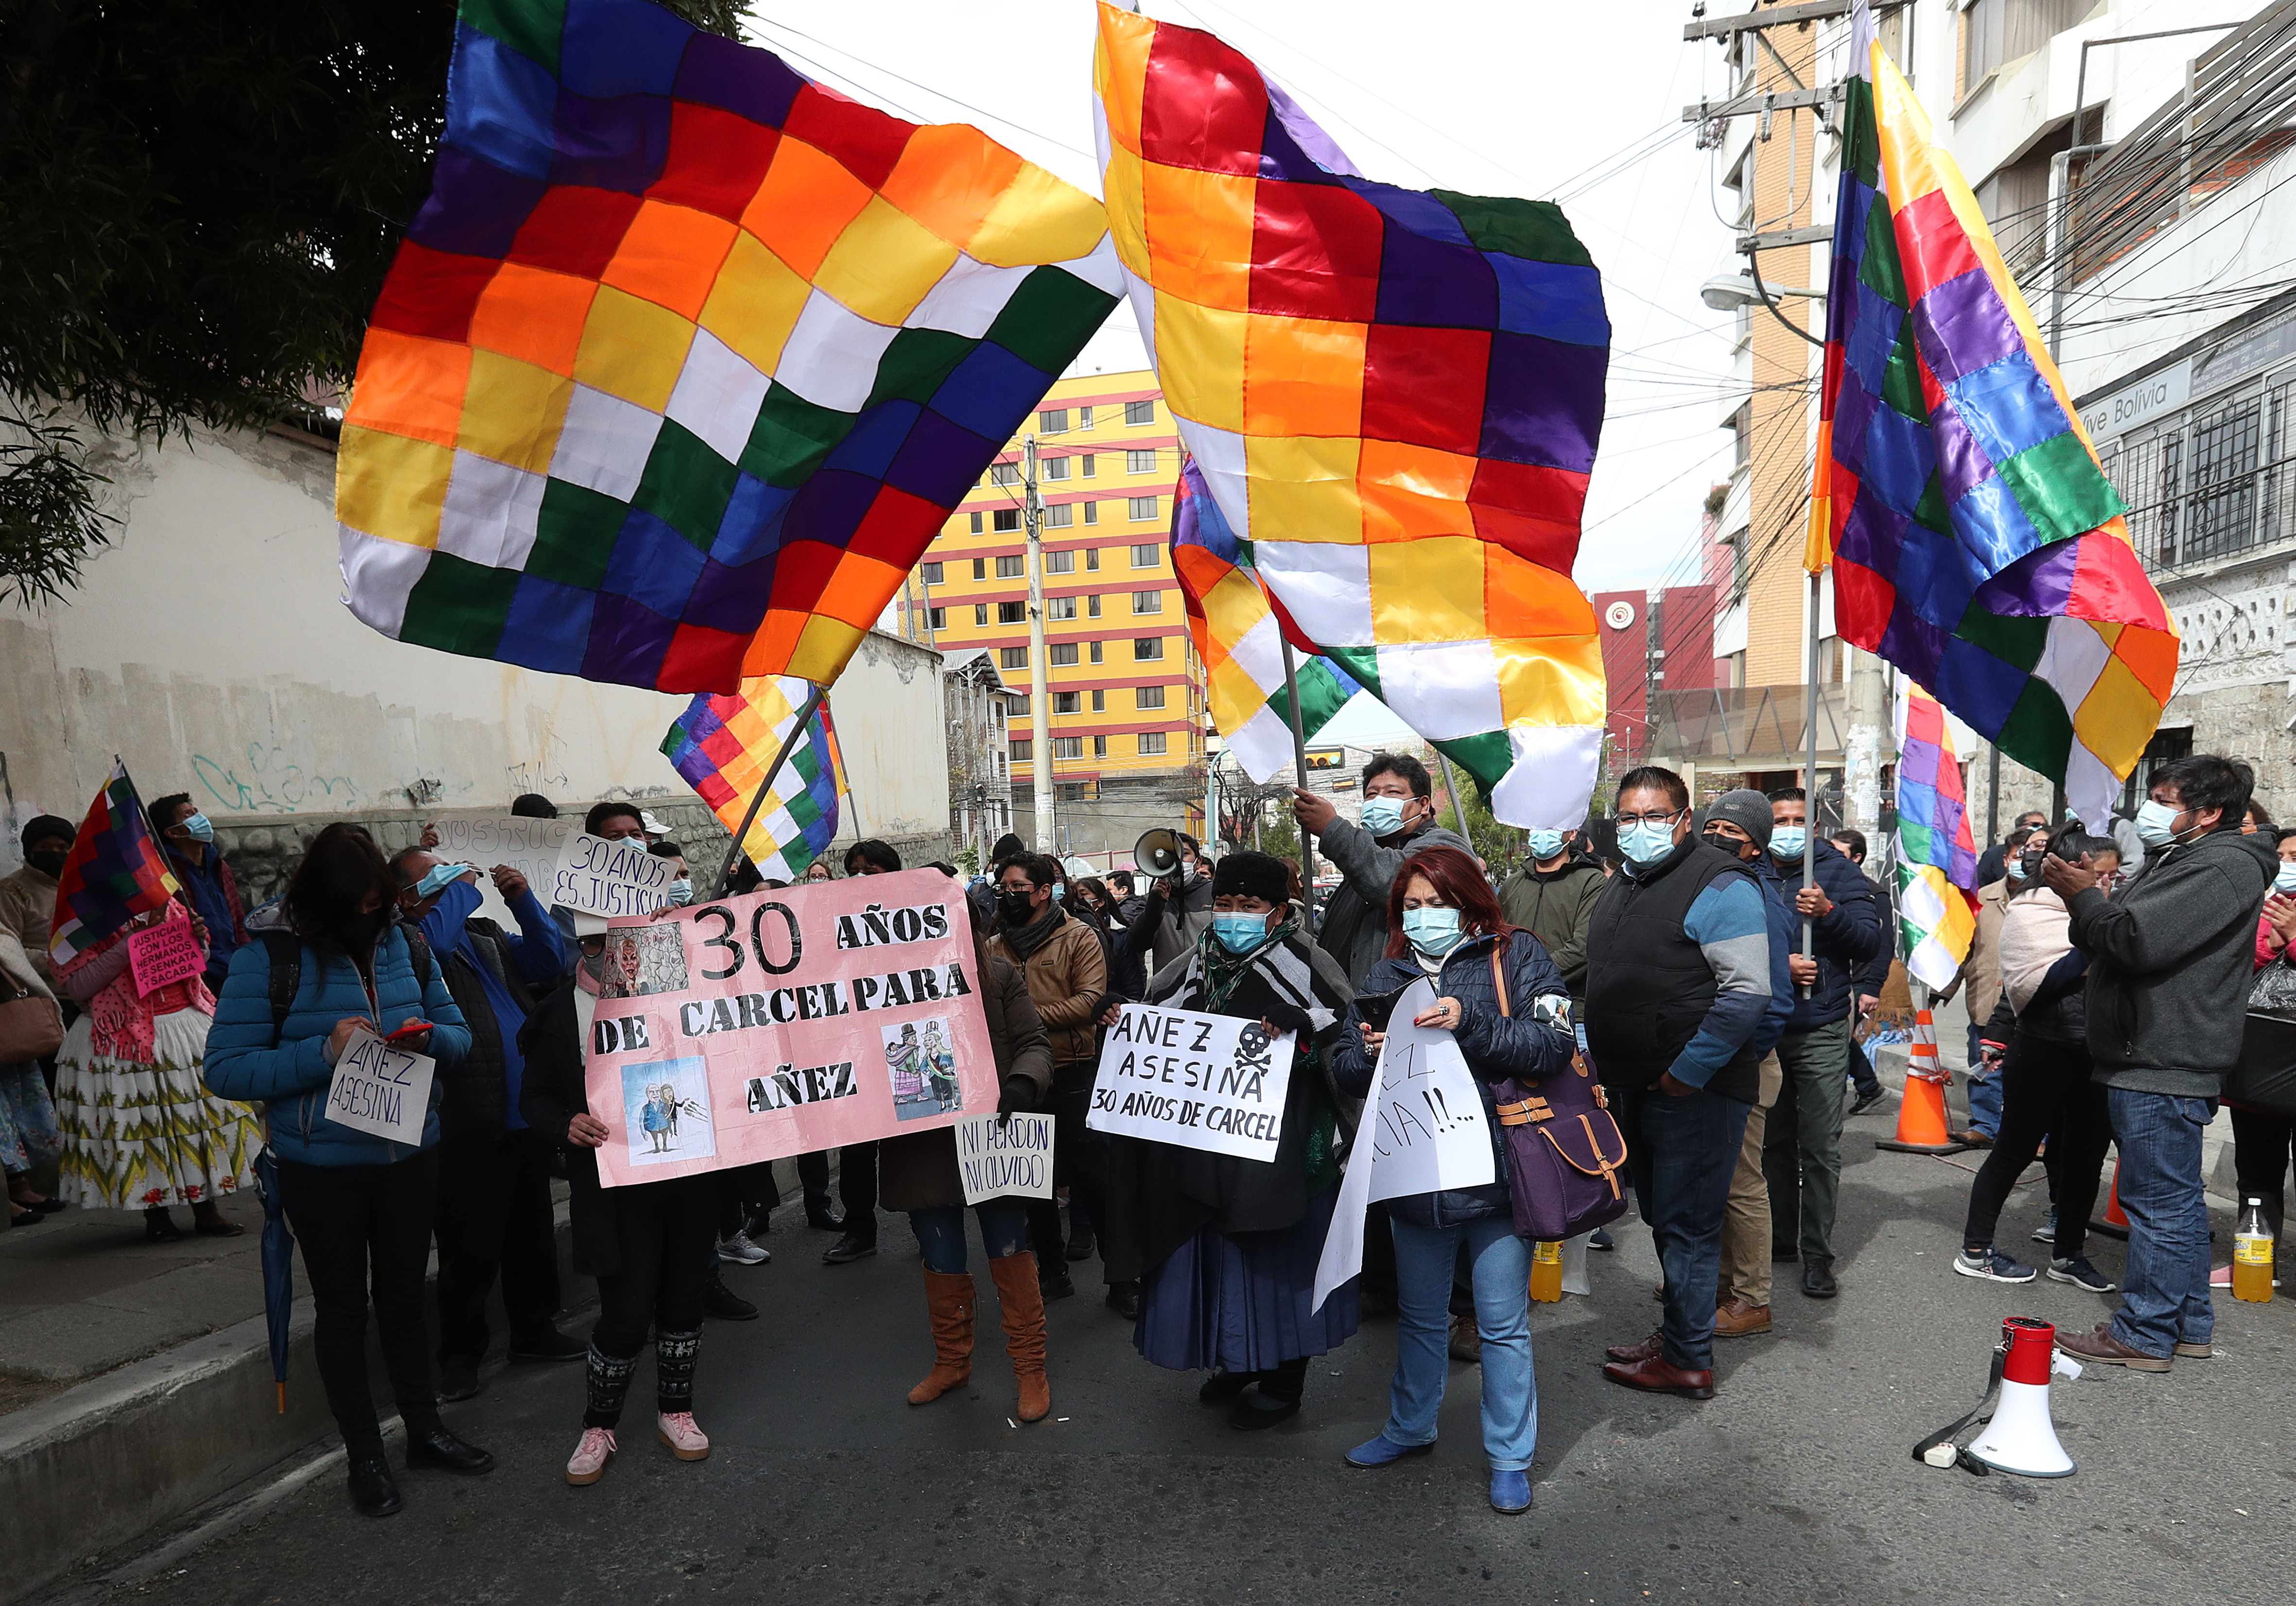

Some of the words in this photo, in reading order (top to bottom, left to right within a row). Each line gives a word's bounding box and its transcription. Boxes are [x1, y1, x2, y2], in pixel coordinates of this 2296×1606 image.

[2114, 382, 2168, 424] Bolivia
[570, 836, 609, 873] 30
[607, 848, 669, 888] AÑOS
[555, 870, 578, 904] ES
[582, 877, 663, 915] JUSTICIA
[134, 921, 187, 949] JUSTICIA!!!
[137, 941, 191, 970] HERMANOS
[140, 941, 159, 957] CON
[163, 933, 183, 947] LOS
[694, 902, 802, 980] 30
[837, 903, 948, 950] AÑOS
[138, 969, 149, 982] DE
[150, 950, 198, 974] SENKATA
[144, 981, 149, 989] Y
[151, 963, 195, 985] SACABA
[594, 1015, 650, 1055] DE
[680, 981, 850, 1037] CARCEL
[852, 963, 973, 1012] PARA
[1112, 1010, 1213, 1053] AÑEZ
[347, 1039, 416, 1086] AÑEZ
[1119, 1051, 1262, 1103] ASESINA
[330, 1073, 400, 1126] ASESINA
[747, 1062, 858, 1114] AÑEZ
[1092, 1088, 1117, 1112] 30
[1119, 1090, 1178, 1121] AÑOS
[1177, 1100, 1205, 1127] DE
[1205, 1106, 1279, 1141] CARCEL
[962, 1121, 979, 1156] NI
[987, 1118, 1048, 1151] PERDON
[965, 1159, 983, 1193] NI
[986, 1154, 1044, 1190] OLVIDO
